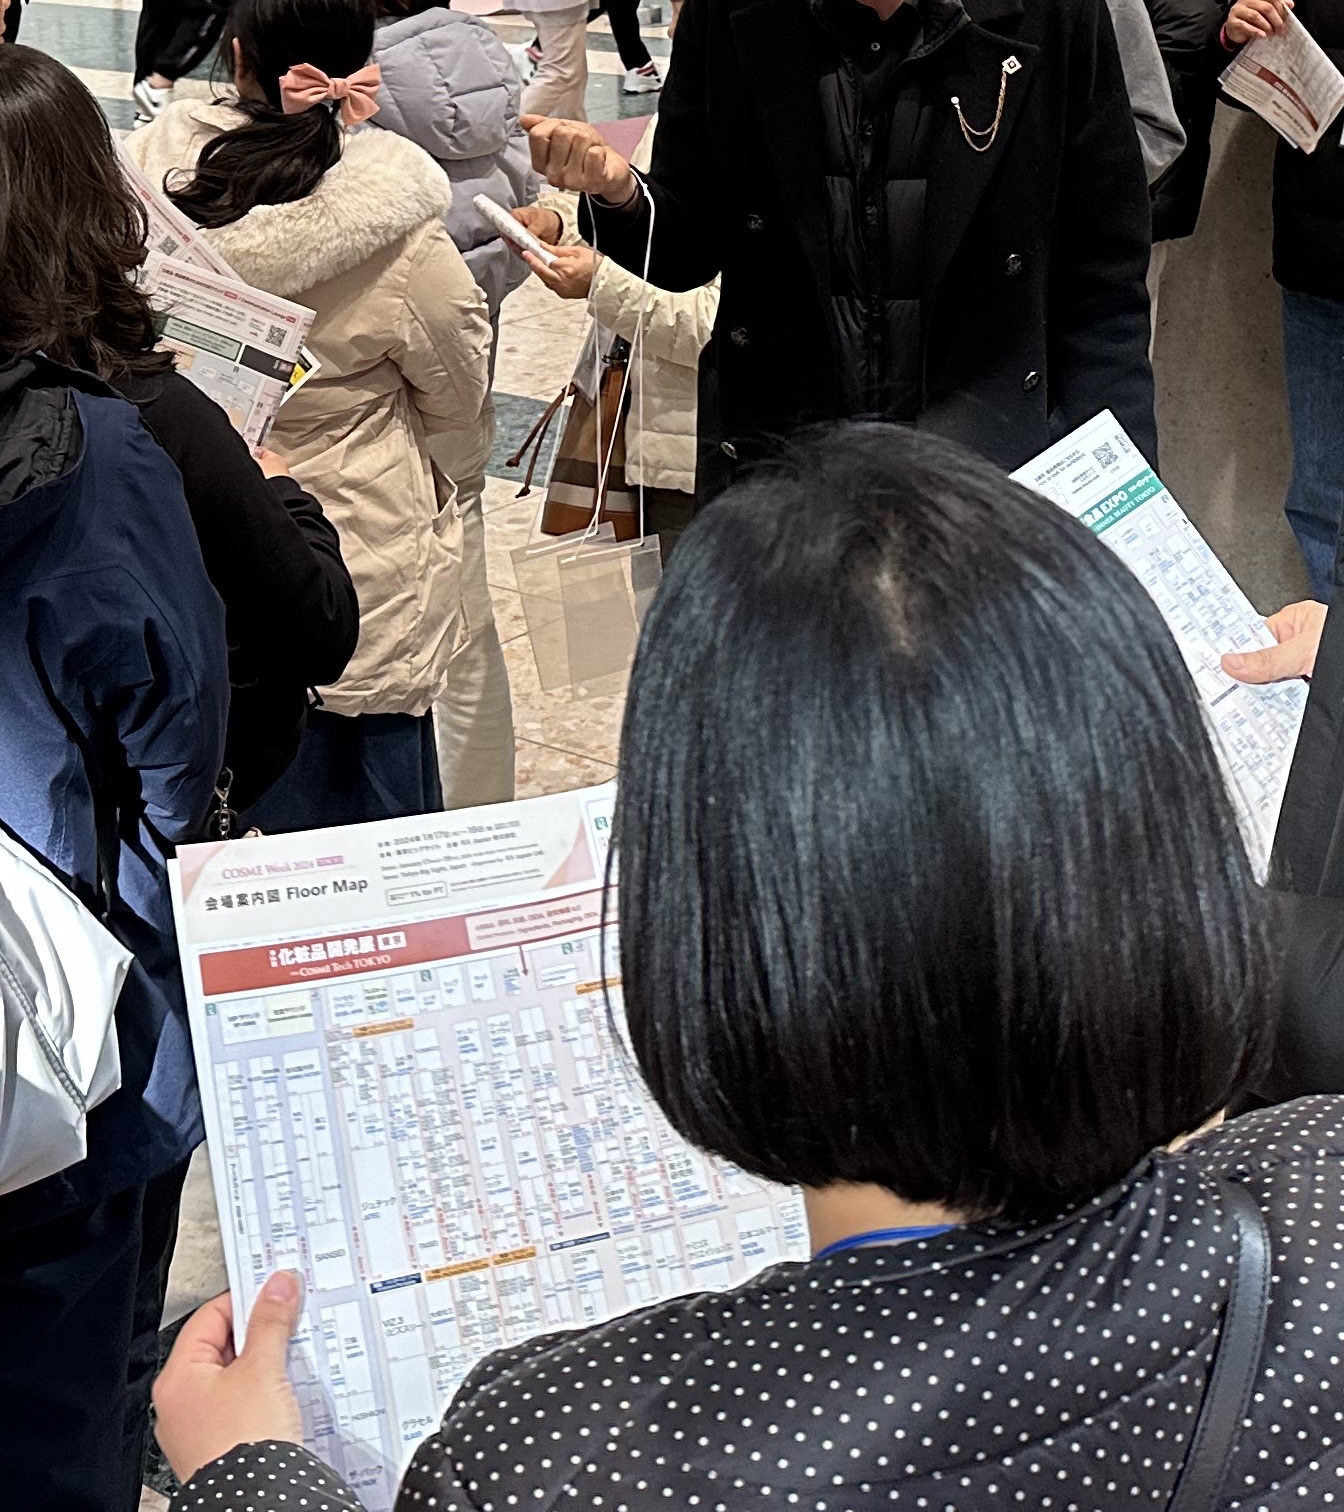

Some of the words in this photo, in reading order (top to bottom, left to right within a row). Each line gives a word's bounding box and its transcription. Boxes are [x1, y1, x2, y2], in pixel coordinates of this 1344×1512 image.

[1100, 490, 1128, 516] EXPO
[221, 865, 264, 880] COSME
[205, 889, 281, 911] 会場案内図
[286, 884, 328, 900] Floor
[332, 878, 369, 894] Map
[353, 955, 392, 970] TOKYO
